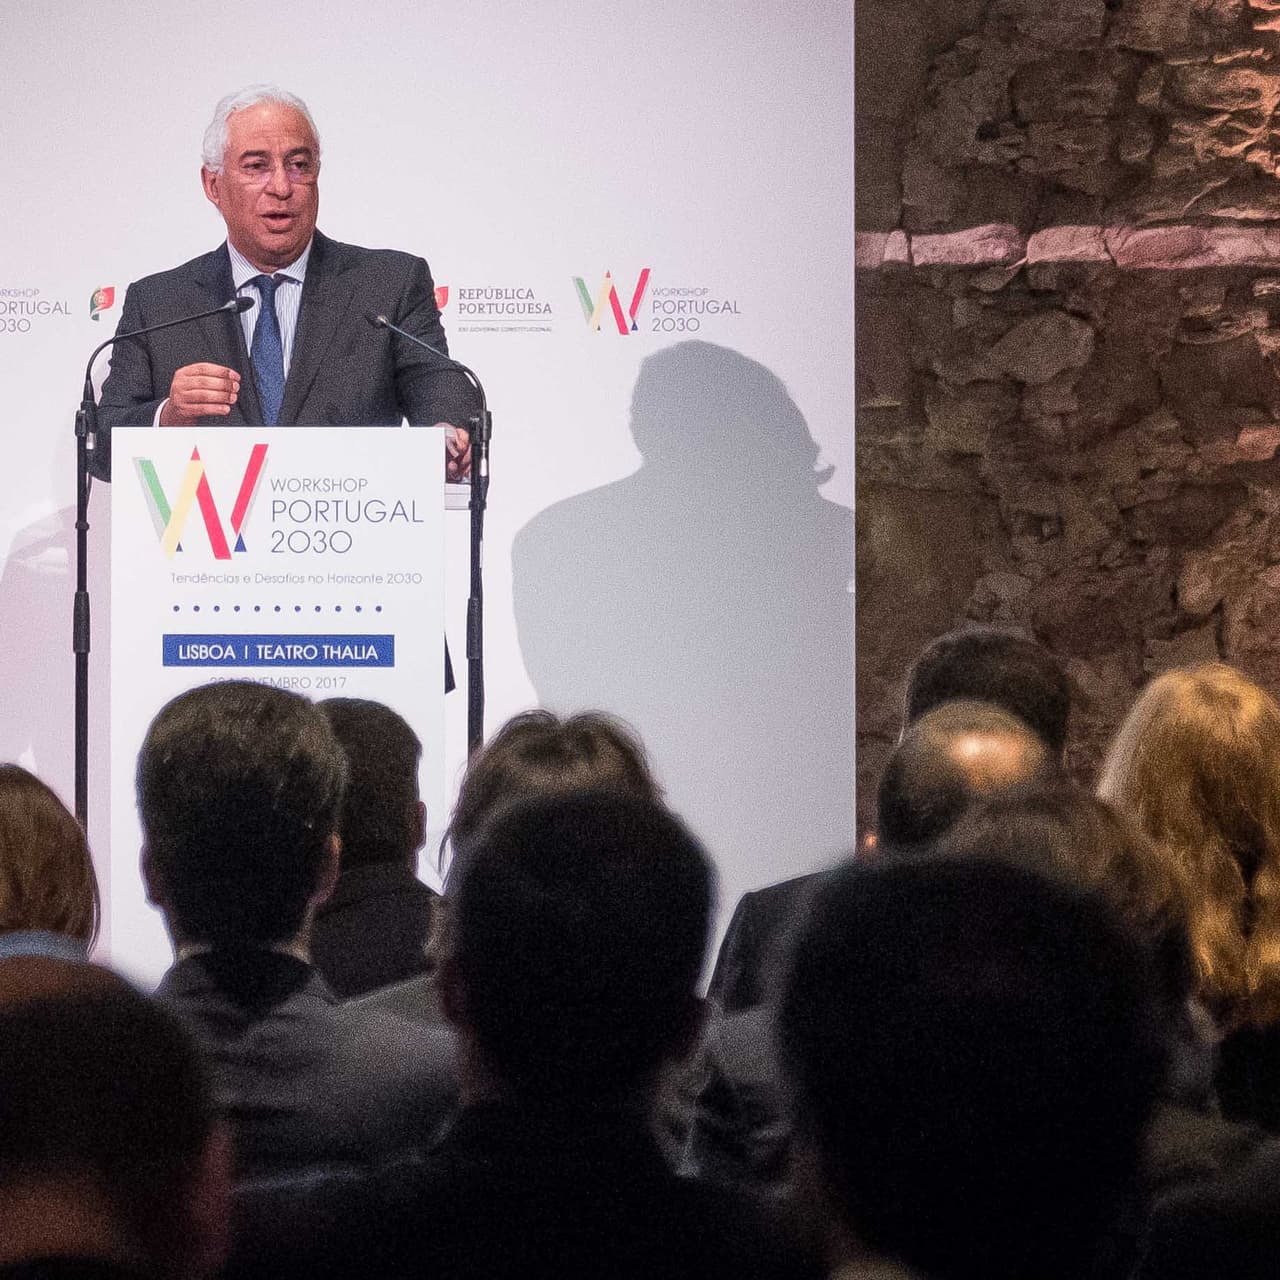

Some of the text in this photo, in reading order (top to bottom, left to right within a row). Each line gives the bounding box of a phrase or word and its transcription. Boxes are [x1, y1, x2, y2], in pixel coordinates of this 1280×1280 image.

[459, 286, 534, 300] REPÚBLICA
[459, 303, 552, 314] PORTUGUESA
[653, 300, 741, 314] PORTUGAL
[652, 317, 700, 331] 2030
[271, 478, 368, 492] WORKSHOP
[273, 500, 424, 523] PORTUGAL
[271, 530, 352, 553] 2030
[172, 573, 239, 584] Tendências
[255, 573, 304, 584] Desafios
[308, 576, 324, 584] no
[328, 573, 383, 584] Horizonte
[387, 573, 422, 584] 2030
[179, 644, 236, 659] LISBOA
[256, 645, 317, 659] TEATRO
[322, 645, 378, 659] THALIA
[316, 677, 346, 688] 2017
